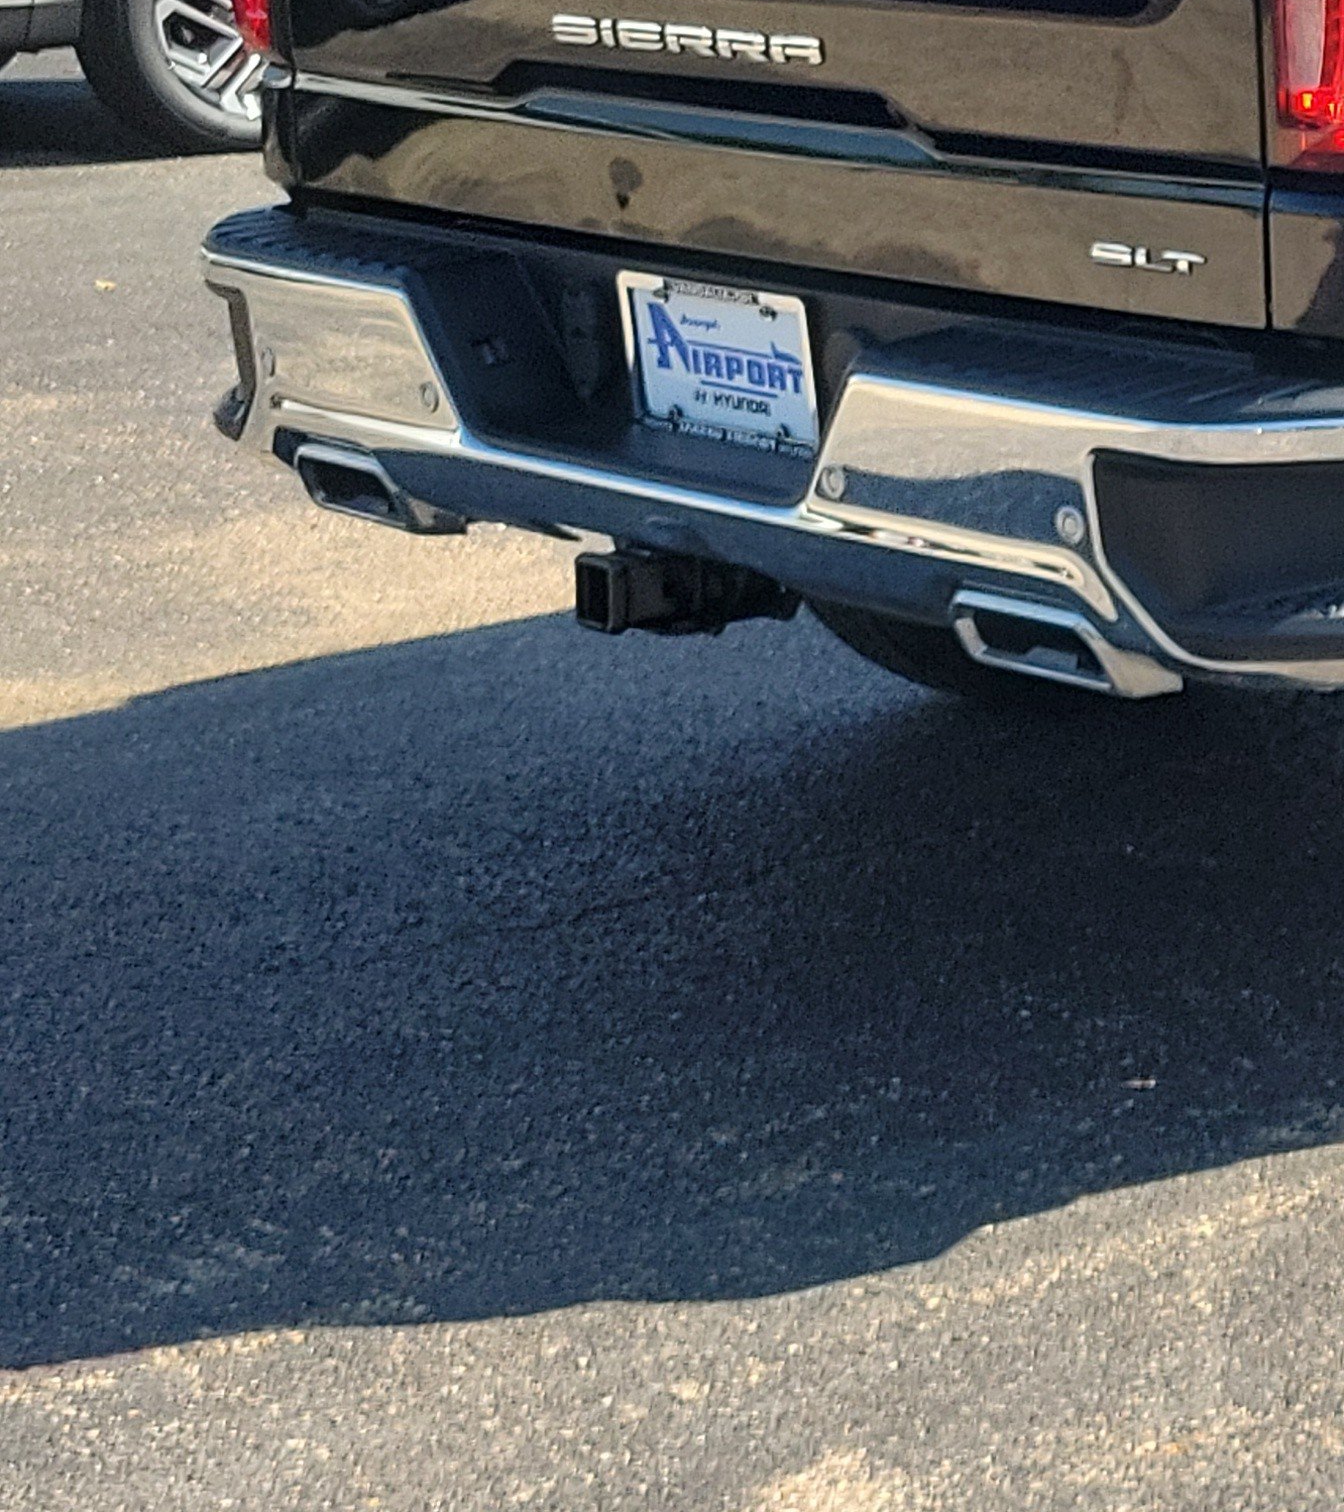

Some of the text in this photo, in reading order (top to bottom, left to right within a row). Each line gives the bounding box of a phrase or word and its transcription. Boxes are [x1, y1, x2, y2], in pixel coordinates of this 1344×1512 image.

[552, 14, 823, 65] SIERRA
[1091, 242, 1206, 276] SLT
[647, 302, 803, 394] AIRPORT
